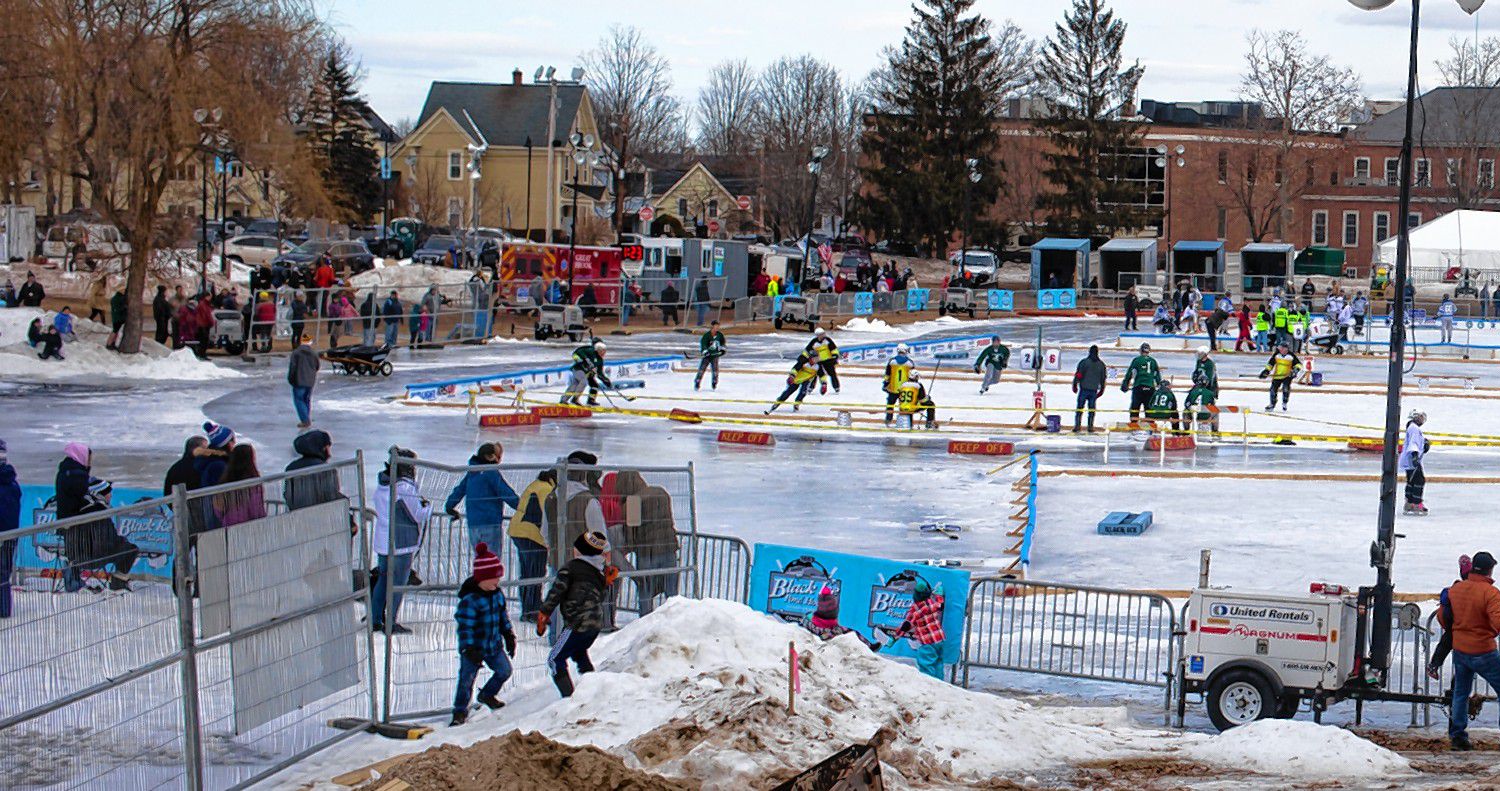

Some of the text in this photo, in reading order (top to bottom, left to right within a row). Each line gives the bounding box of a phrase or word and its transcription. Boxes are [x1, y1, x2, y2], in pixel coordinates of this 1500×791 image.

[1024, 353, 1031, 363] 2
[1049, 354, 1056, 364] 6
[897, 369, 902, 382] 1
[538, 407, 562, 417] KEEP
[487, 415, 536, 425] KEEP OFF
[721, 432, 764, 443] KEEP OFF
[952, 442, 1006, 453] KEEP OFF
[769, 576, 840, 598] Black Ie
[871, 592, 913, 612] Blac
[1229, 605, 1310, 621] United Rentals
